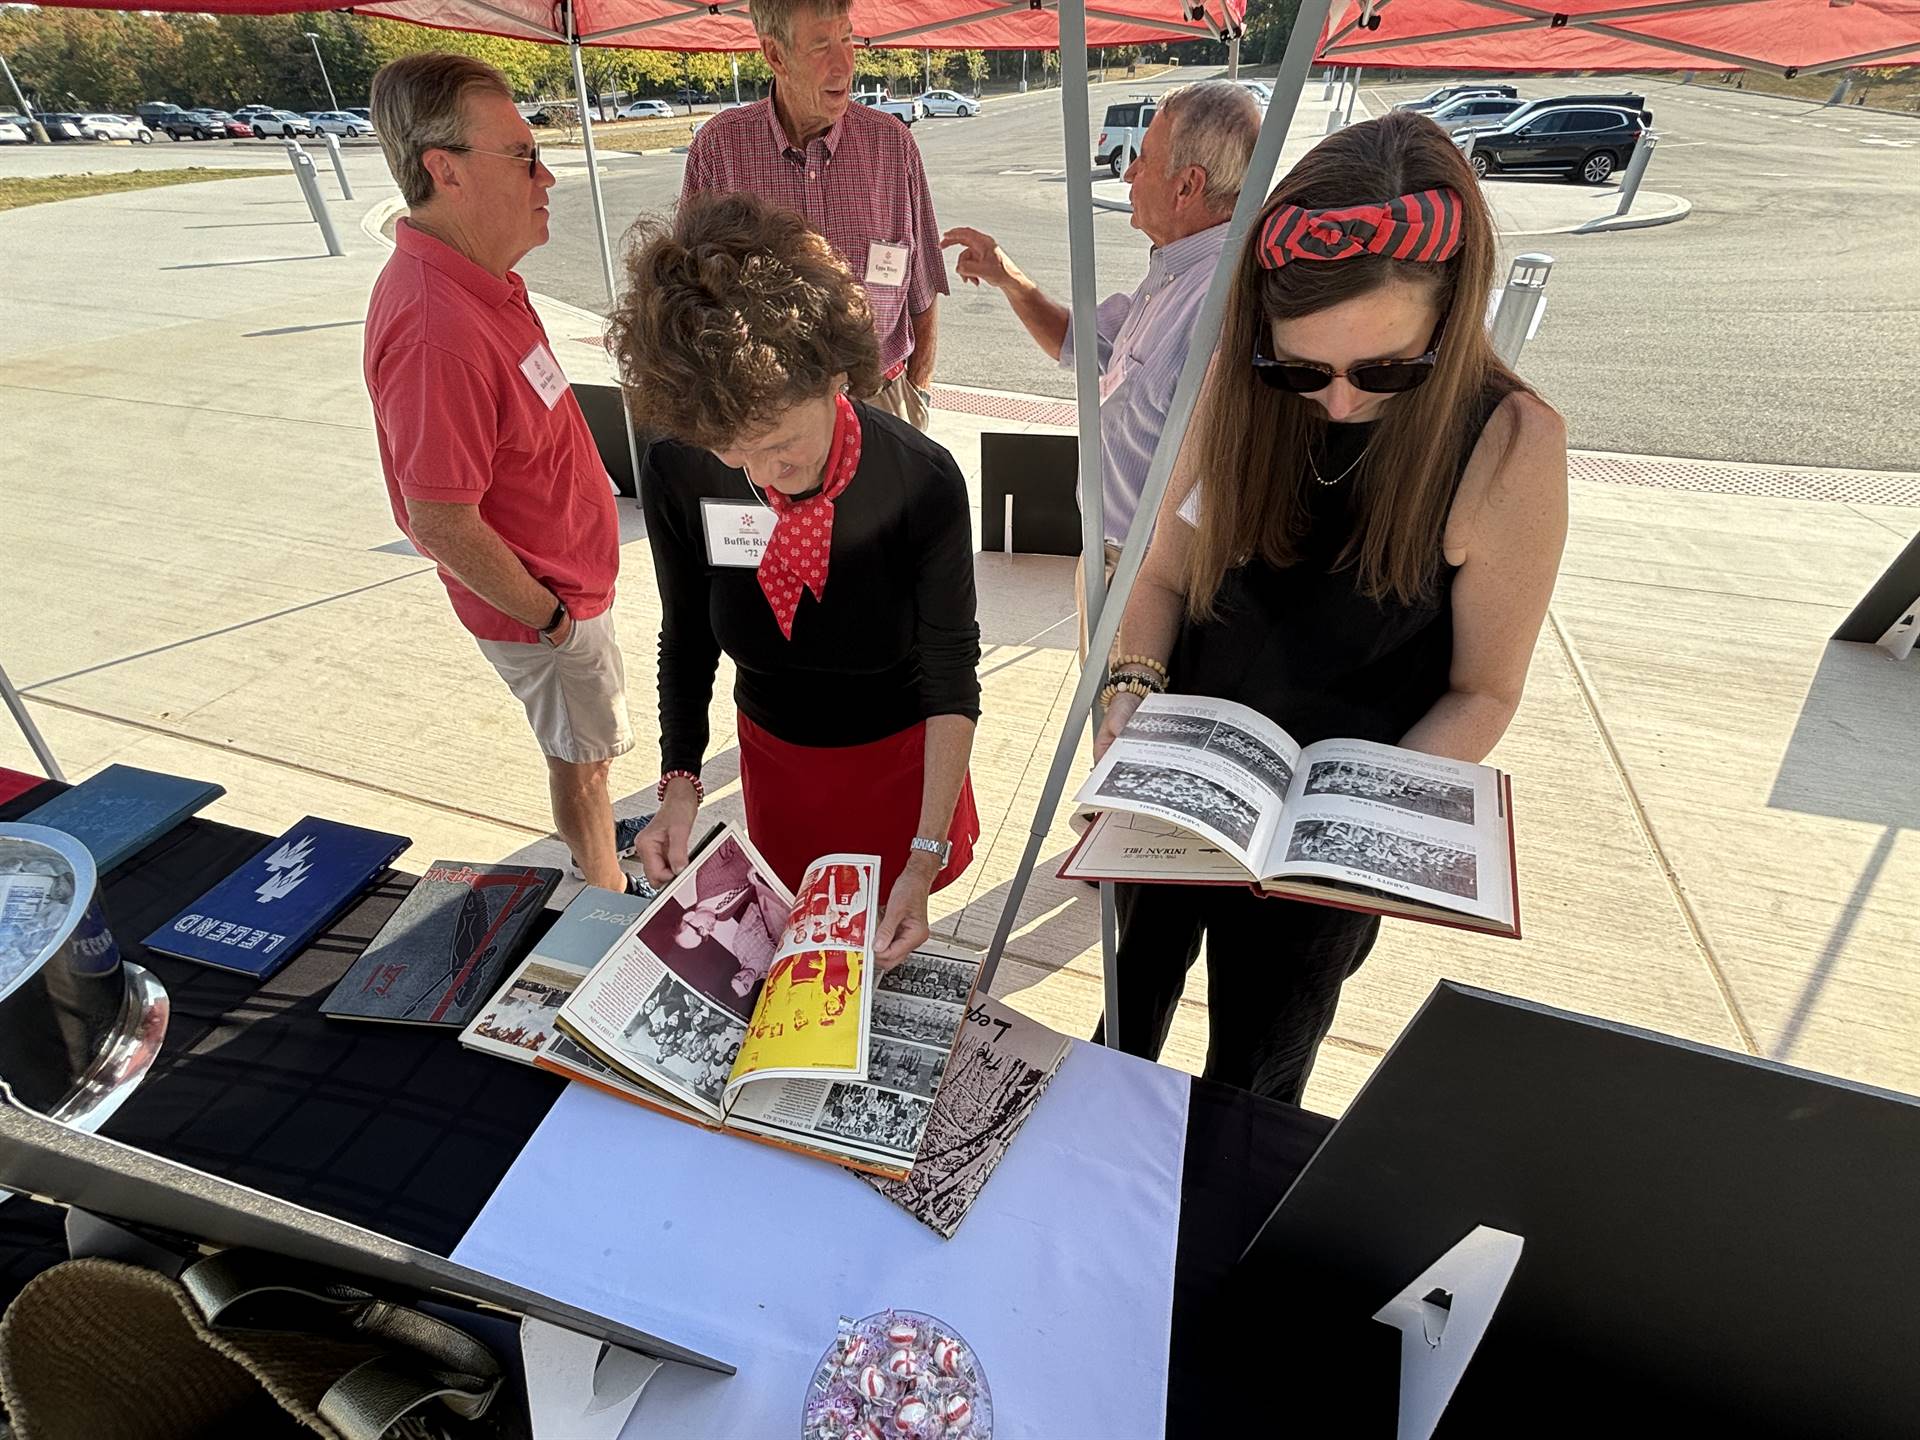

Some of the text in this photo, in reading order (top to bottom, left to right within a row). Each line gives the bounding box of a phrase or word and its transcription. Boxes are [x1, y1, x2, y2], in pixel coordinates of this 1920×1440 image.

[723, 536, 751, 546] Buffie
[1146, 847, 1187, 855] INDIAN
[1345, 870, 1410, 890] VARSITY TRACK
[173, 914, 286, 954] LEGEND
